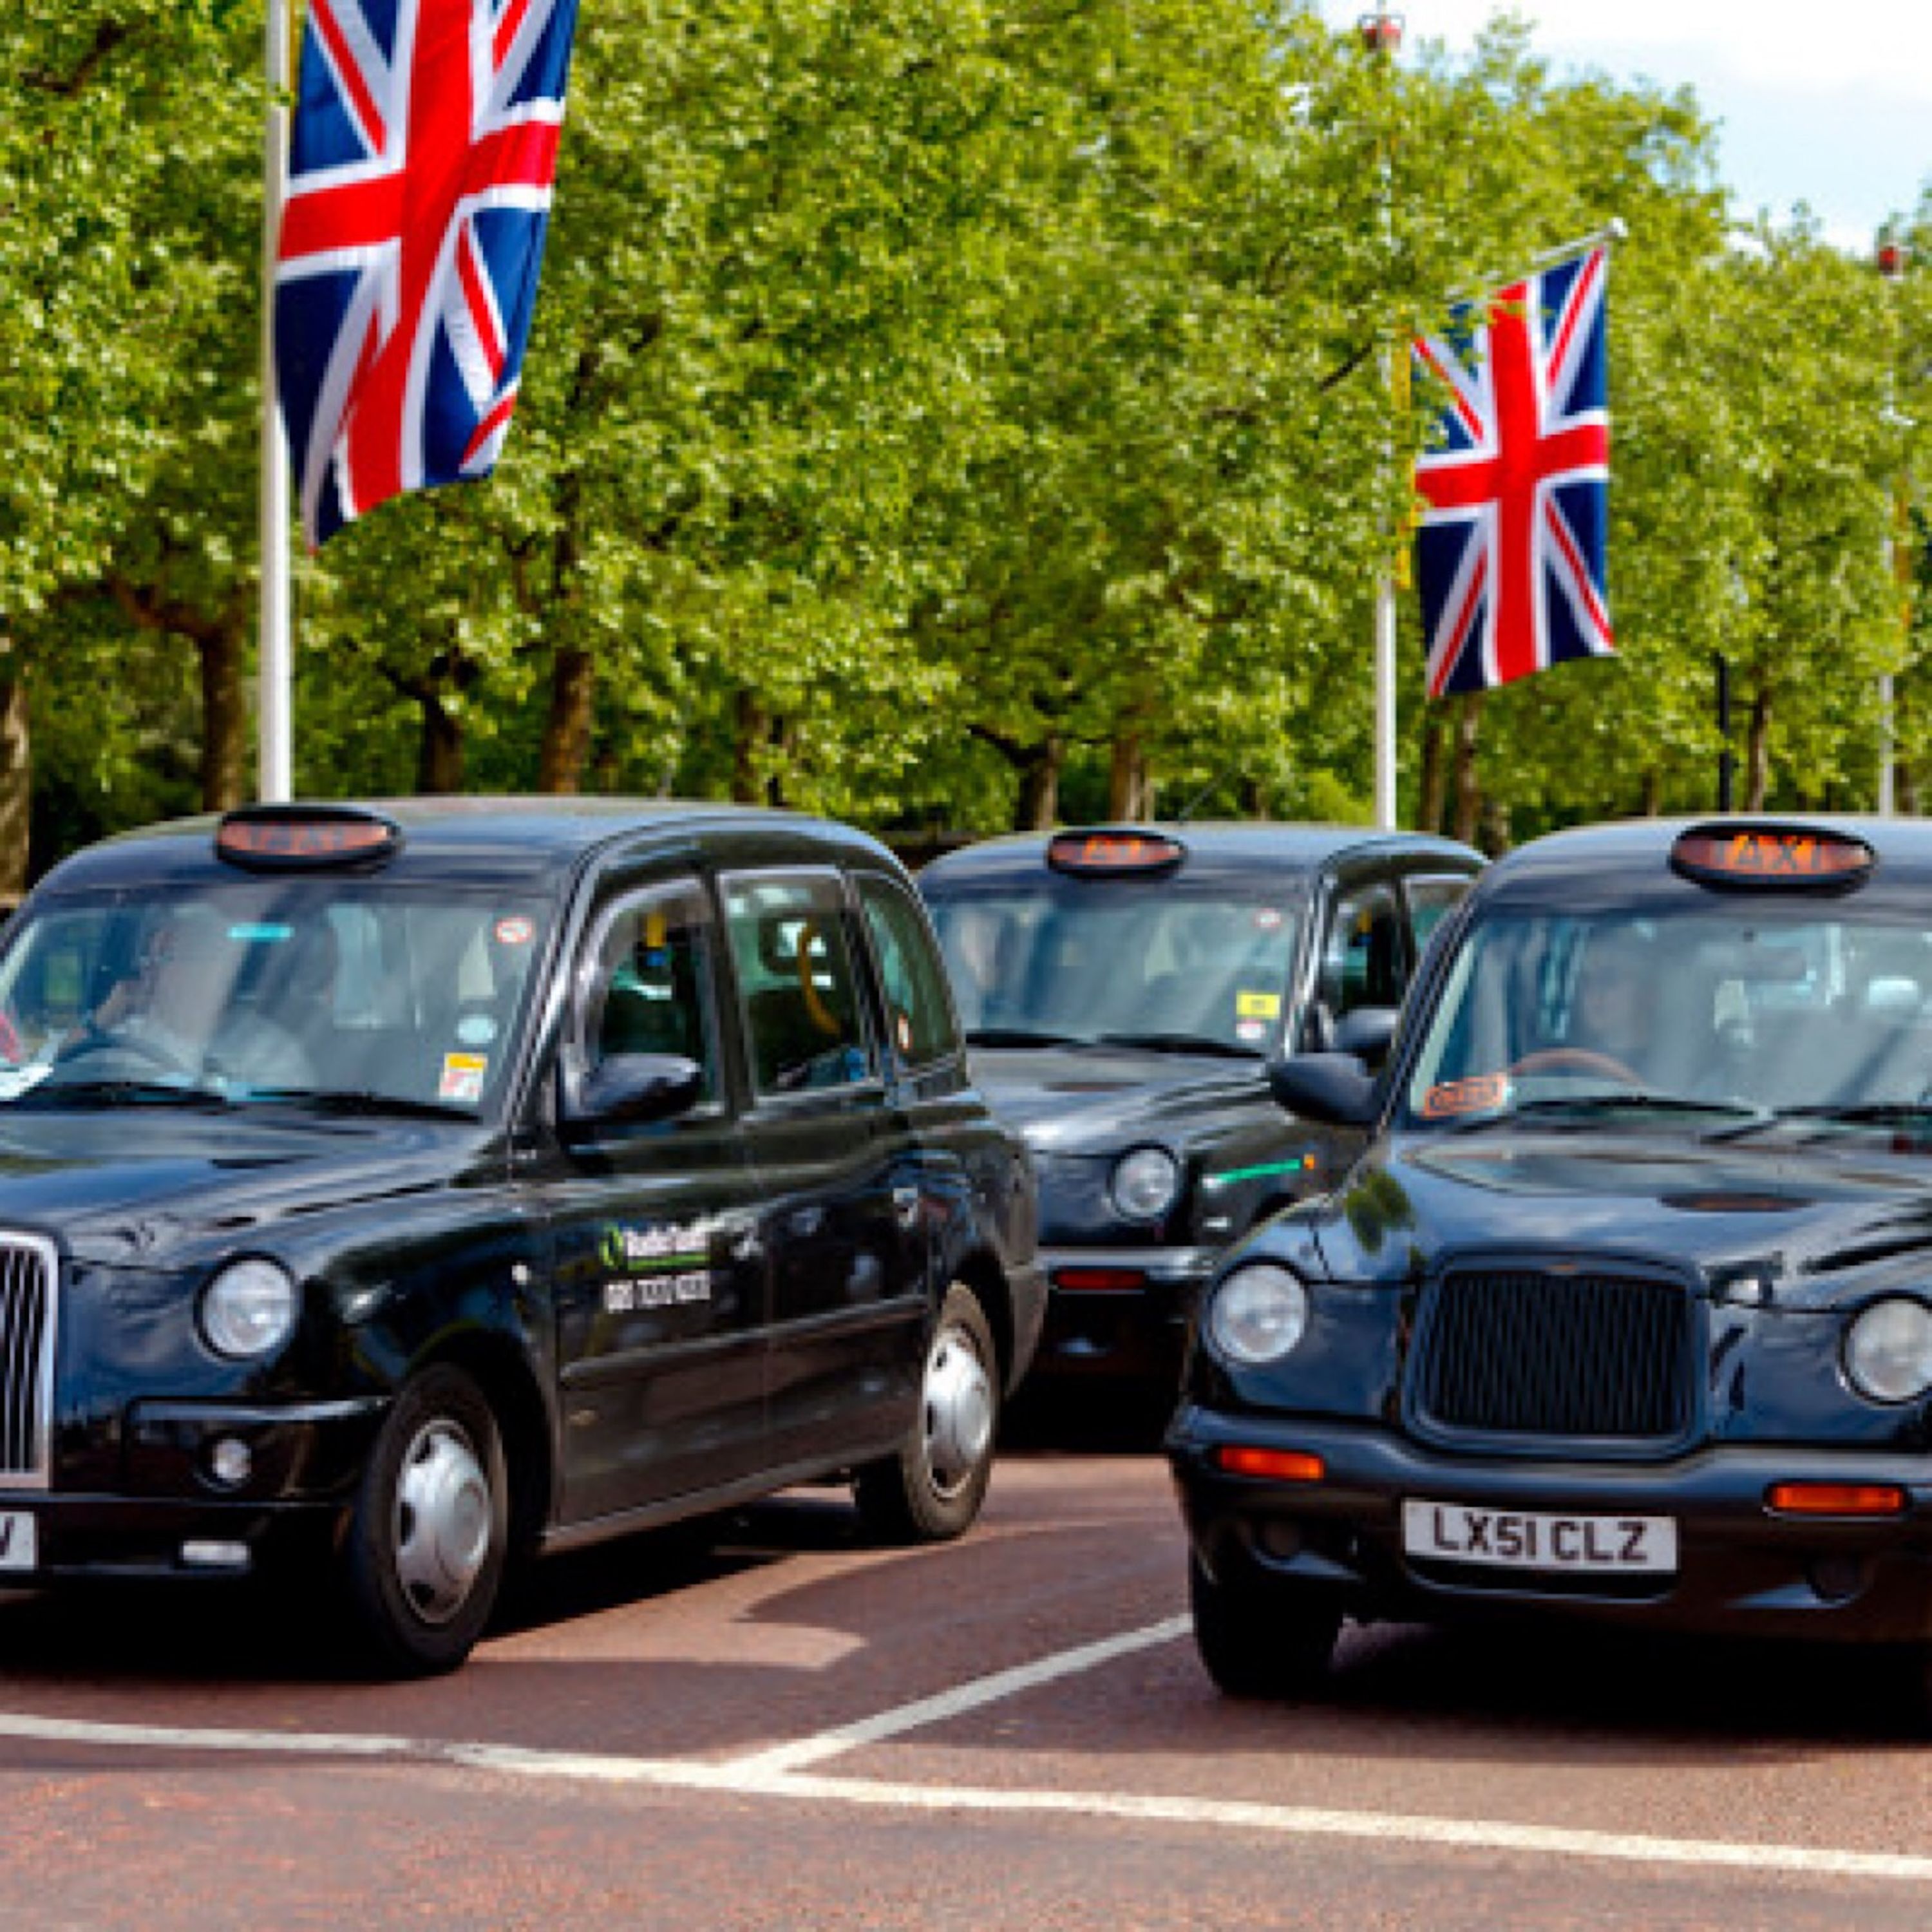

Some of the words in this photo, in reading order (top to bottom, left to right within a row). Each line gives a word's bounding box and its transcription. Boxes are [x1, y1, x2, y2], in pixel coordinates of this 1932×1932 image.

[1710, 838, 1822, 871] TAXI
[1434, 1506, 1537, 1560] LX51
[1550, 1520, 1648, 1562] CLZ
